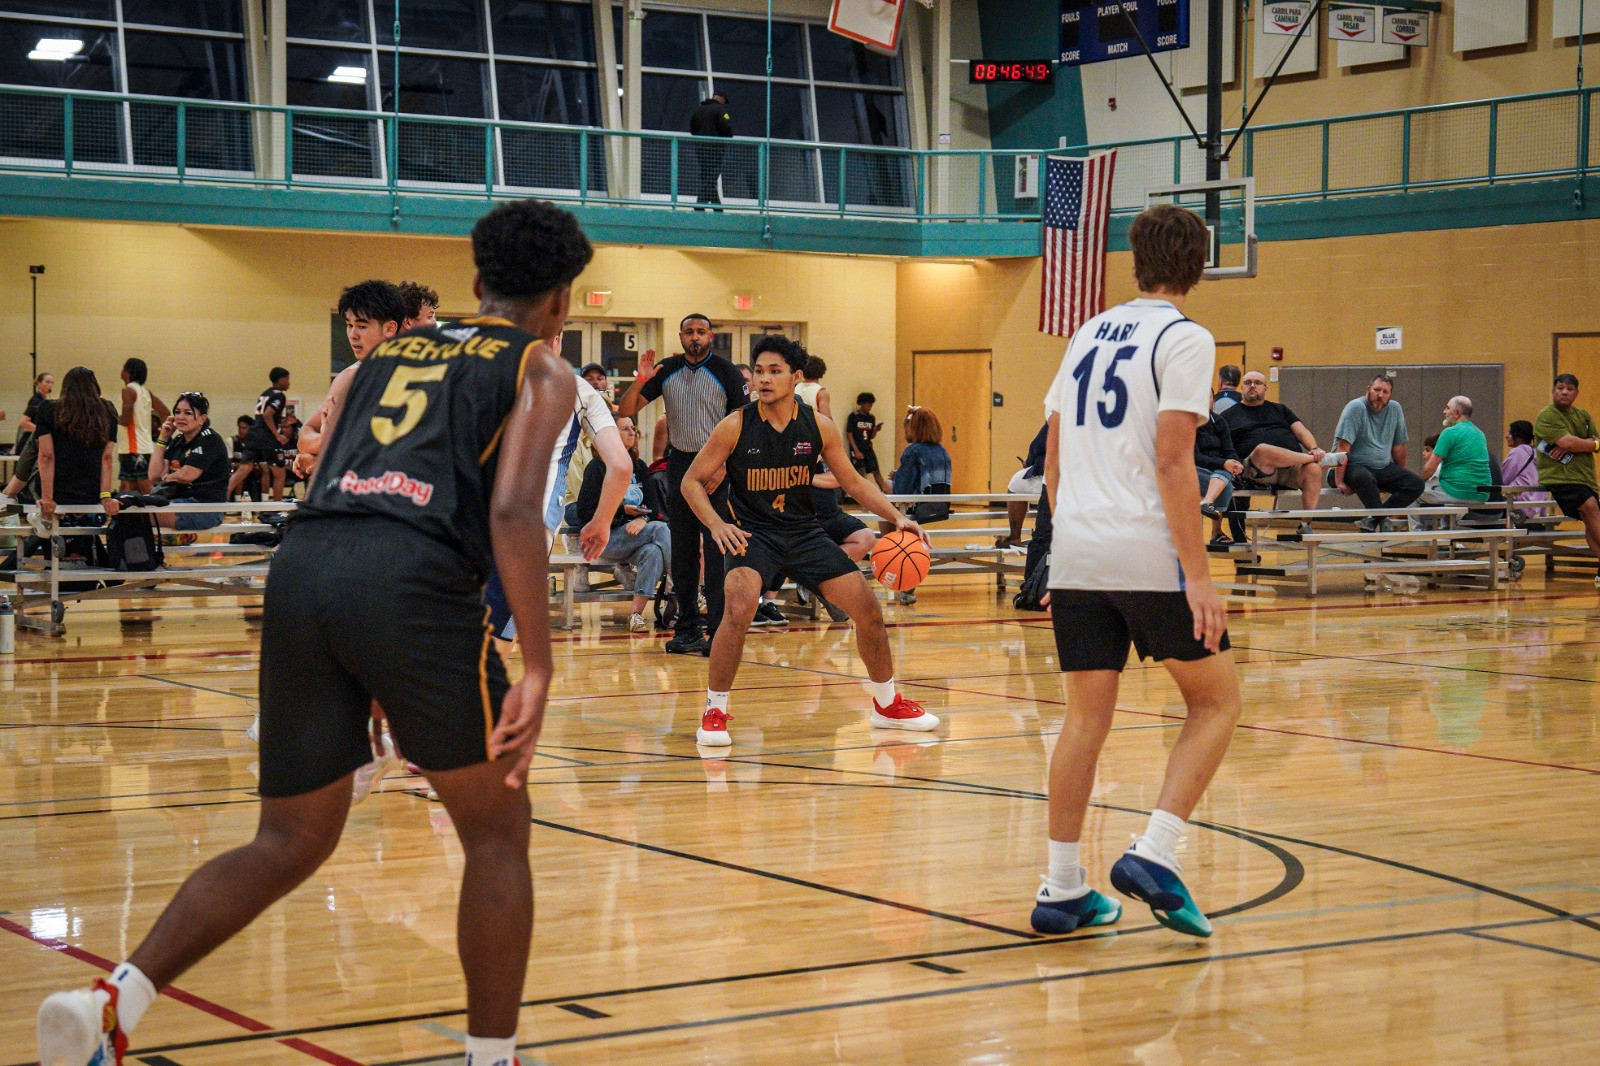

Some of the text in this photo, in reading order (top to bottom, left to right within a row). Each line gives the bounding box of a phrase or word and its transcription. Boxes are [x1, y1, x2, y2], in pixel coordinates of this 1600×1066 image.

[1097, 1, 1138, 17] PLAYER FOUL
[1061, 12, 1080, 23] FOULS
[1342, 22, 1360, 30] PASAR
[1395, 26, 1416, 34] CORRER
[1157, 34, 1178, 46] SCORE
[1107, 42, 1128, 54] MATCH
[1061, 50, 1080, 62] SCORE
[975, 64, 1047, 80] 08:46:49
[627, 335, 635, 350] 5
[1072, 345, 1139, 429] 15
[370, 363, 448, 446] 5
[747, 465, 810, 492] INDONESIA
[771, 493, 786, 513] 4
